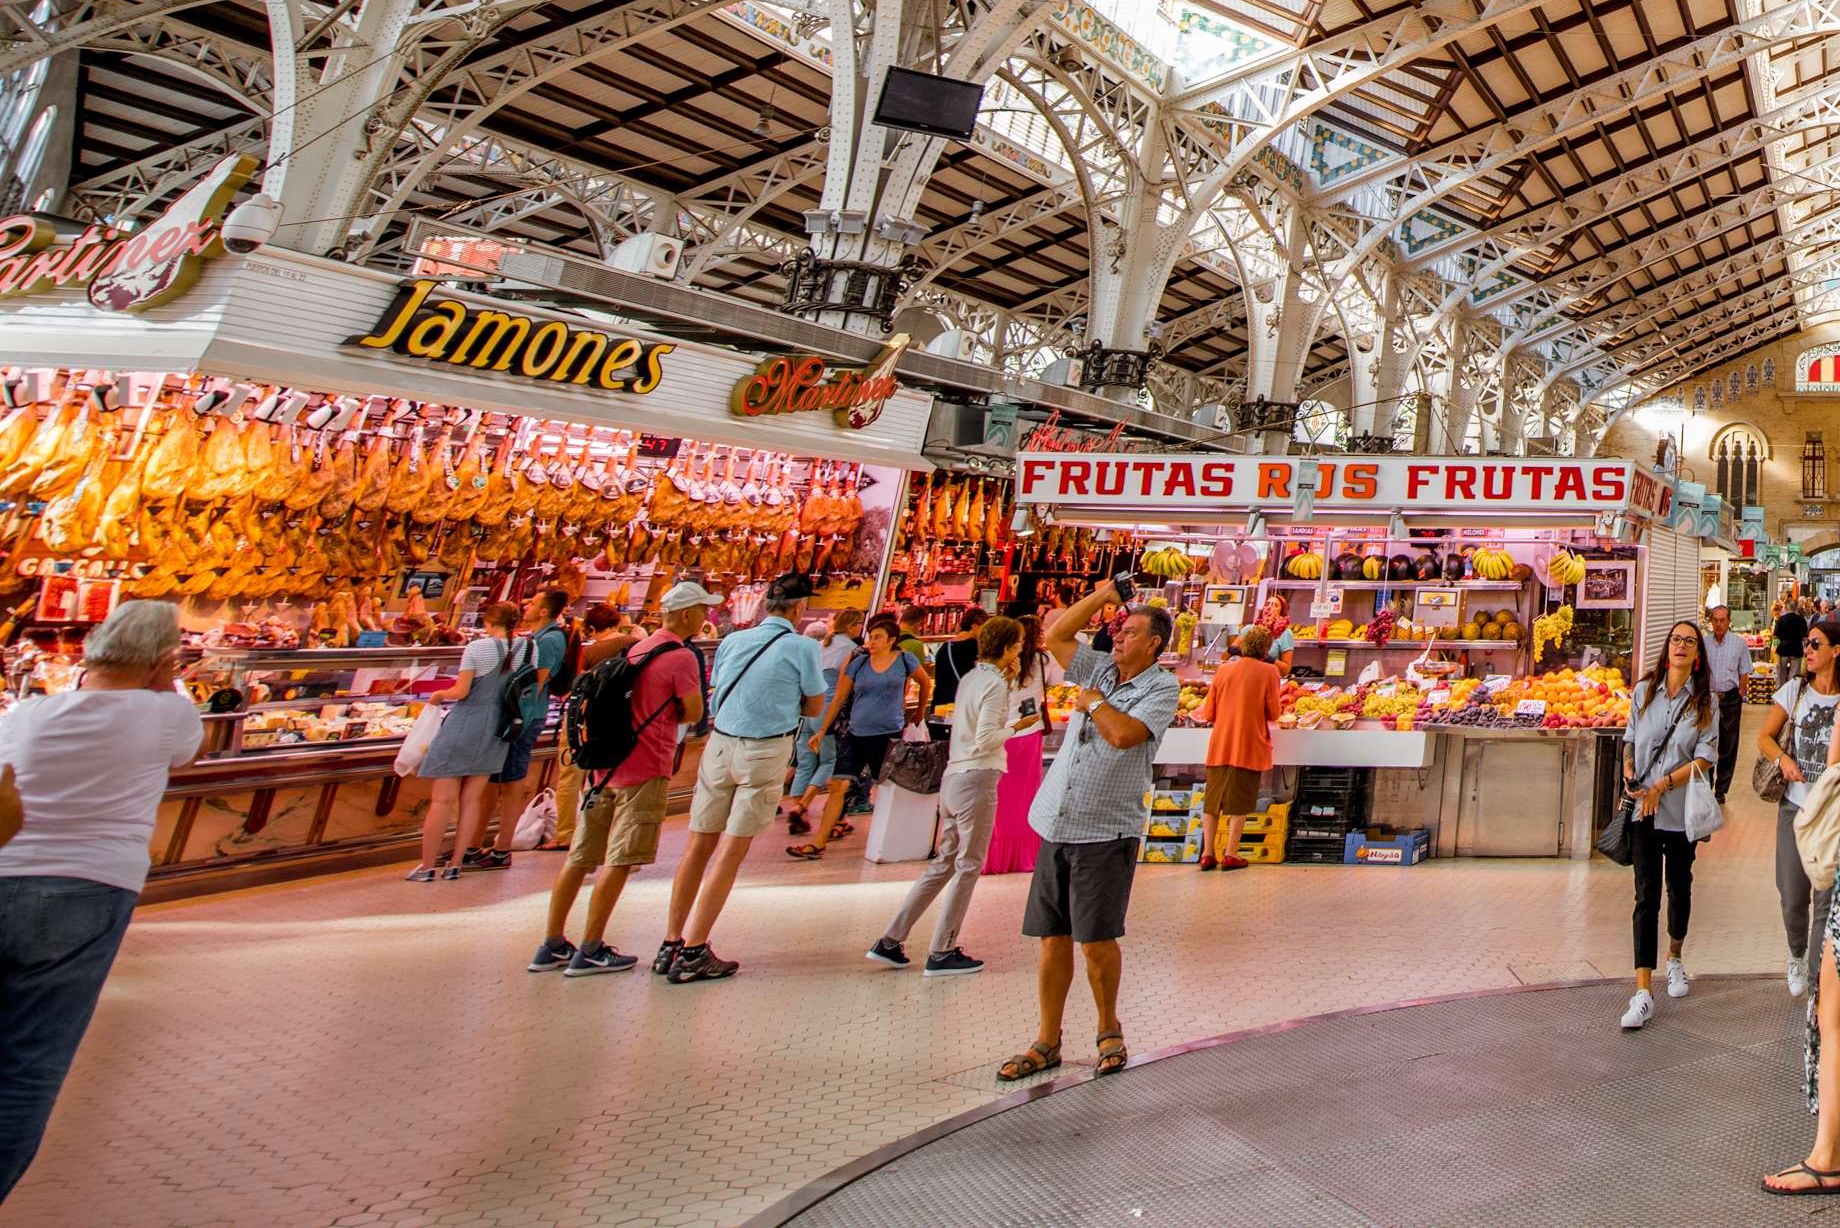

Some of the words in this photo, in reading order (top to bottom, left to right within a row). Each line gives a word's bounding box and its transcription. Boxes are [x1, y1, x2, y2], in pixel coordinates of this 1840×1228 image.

[360, 280, 677, 394] Jamones
[743, 356, 898, 416] Martinez
[1022, 460, 1235, 497] FRUTAS
[1407, 465, 1625, 501] FRUTAS
